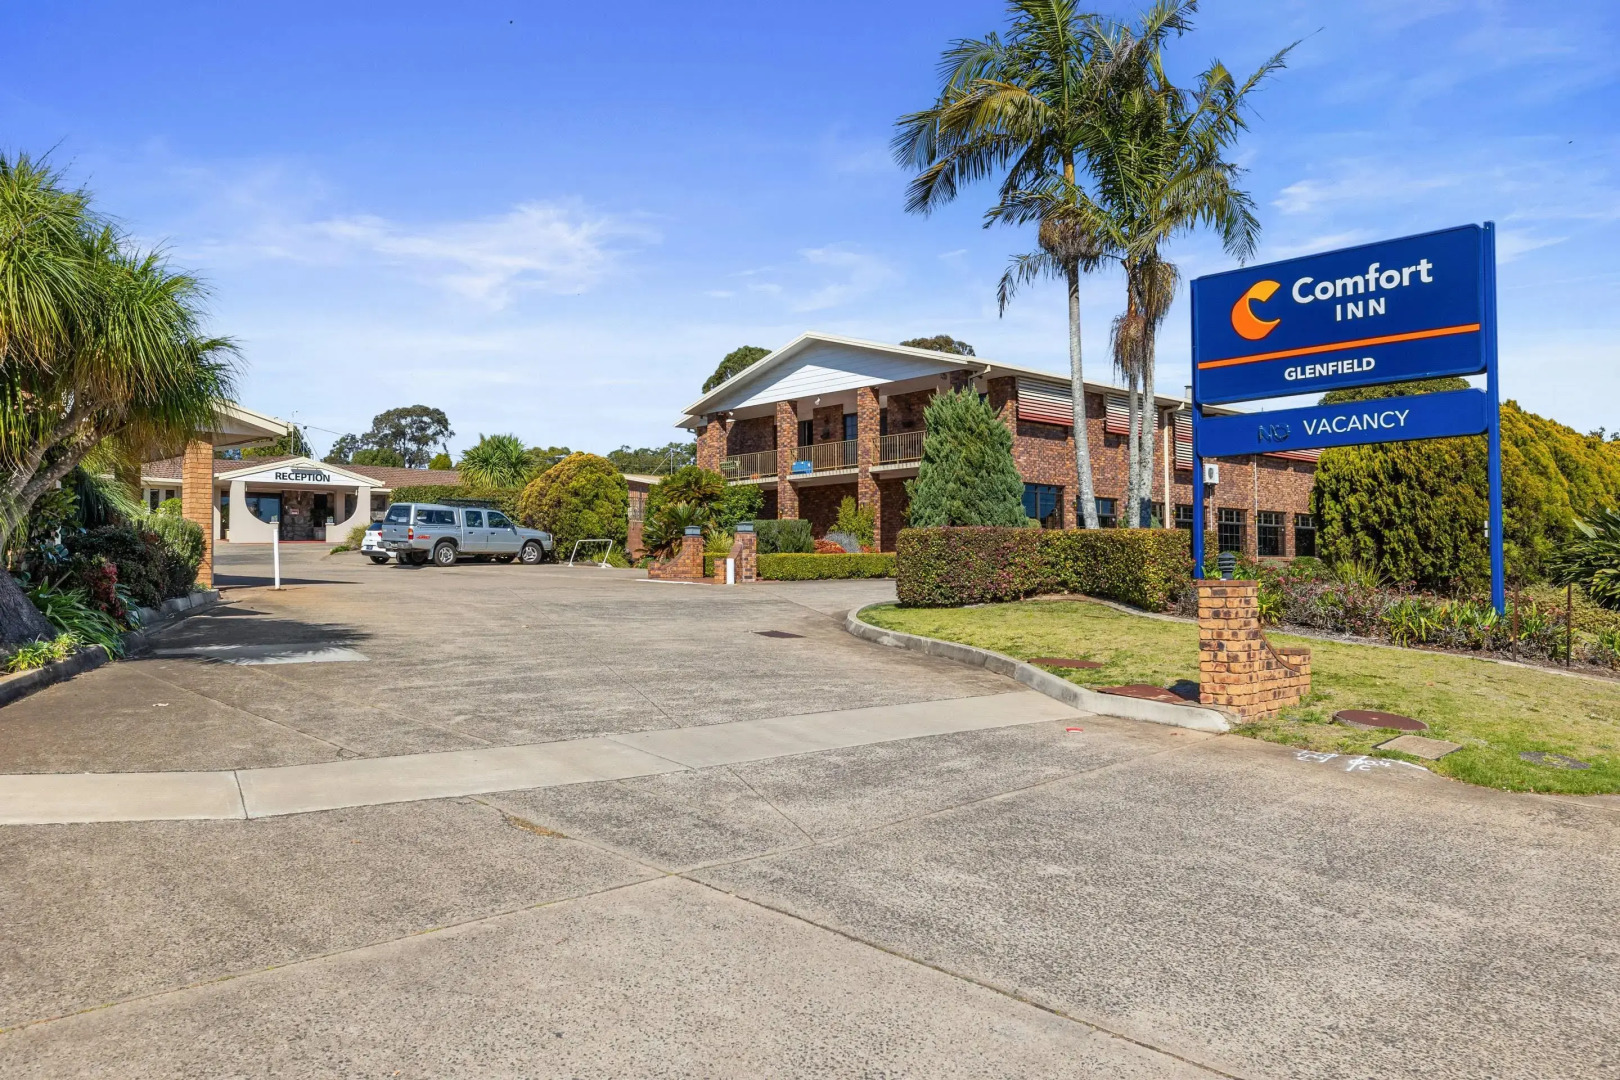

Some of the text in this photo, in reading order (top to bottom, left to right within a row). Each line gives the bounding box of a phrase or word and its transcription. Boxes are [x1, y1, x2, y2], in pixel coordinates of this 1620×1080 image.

[1292, 258, 1433, 304] Comfort
[1336, 297, 1386, 322] INN
[1284, 357, 1376, 381] GLENFIELD
[1303, 409, 1409, 436] VACANCY
[275, 471, 331, 482] RECEPTION
